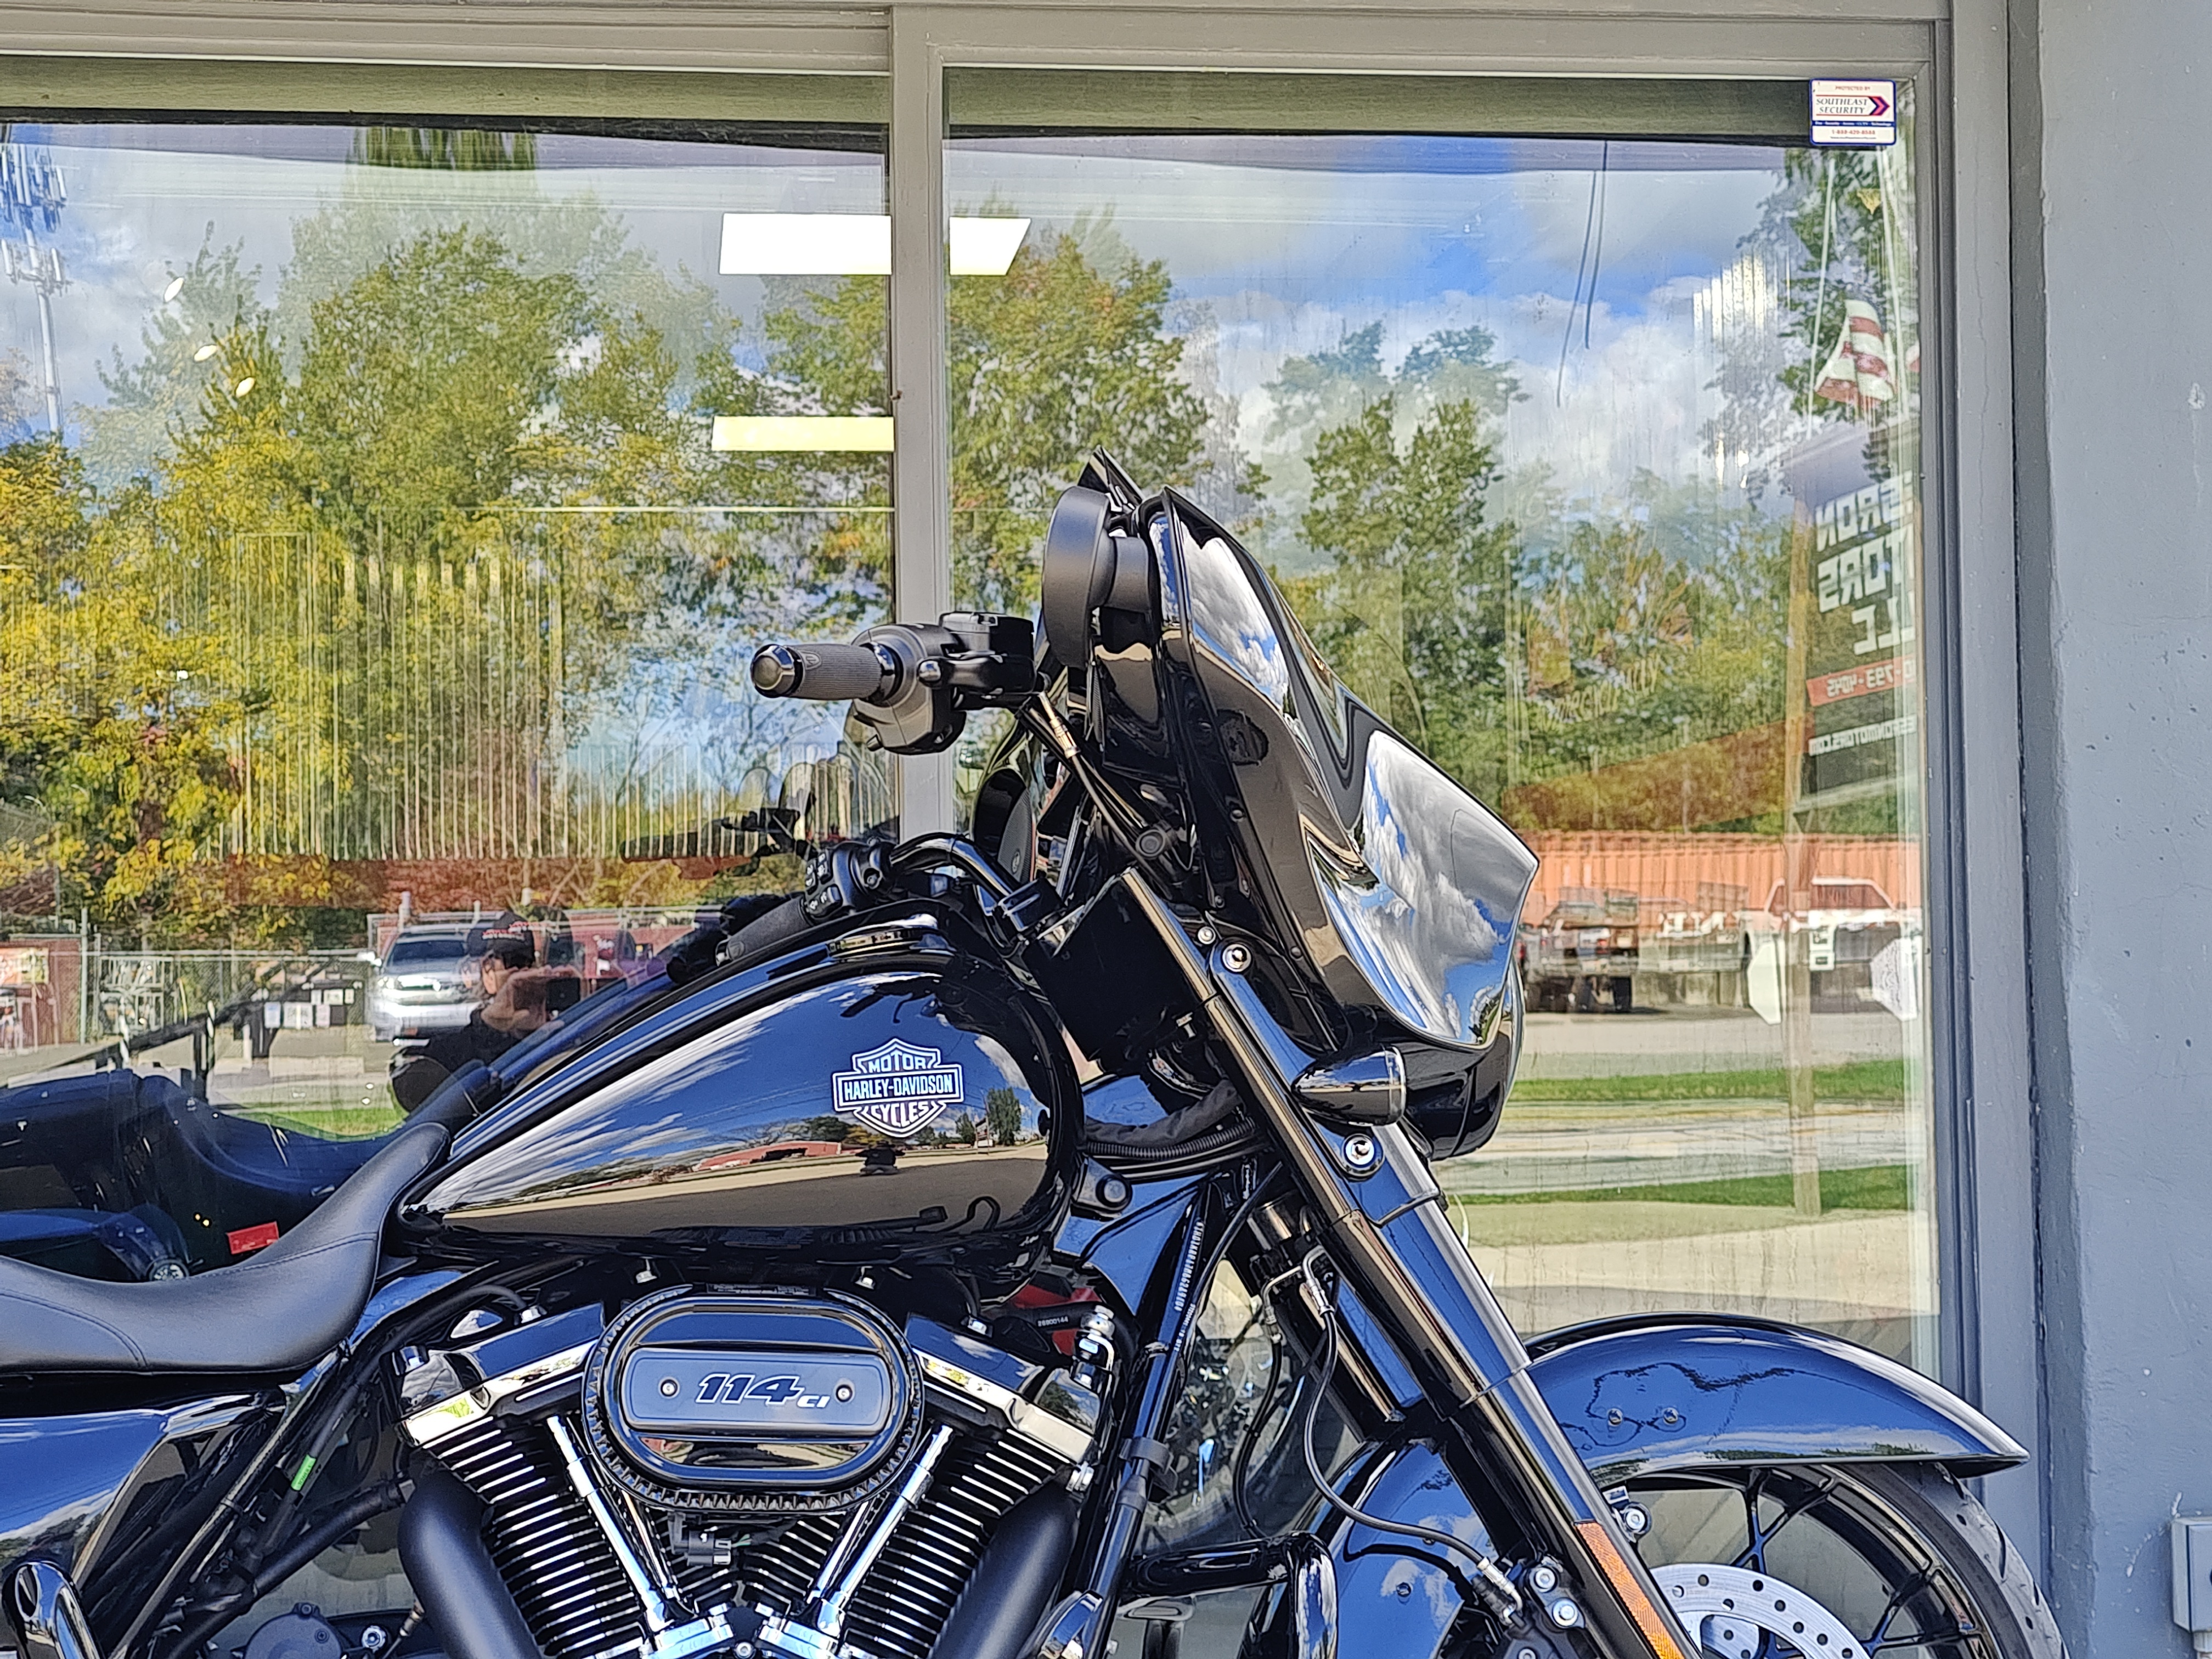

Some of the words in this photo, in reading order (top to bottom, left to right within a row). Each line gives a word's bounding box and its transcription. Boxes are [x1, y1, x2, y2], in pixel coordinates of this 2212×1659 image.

[868, 1049, 927, 1073] MOTOR
[844, 1074, 953, 1101] HARLEY-DAVIDSON
[871, 1101, 929, 1127] CYCLES
[696, 1373, 805, 1406] 114
